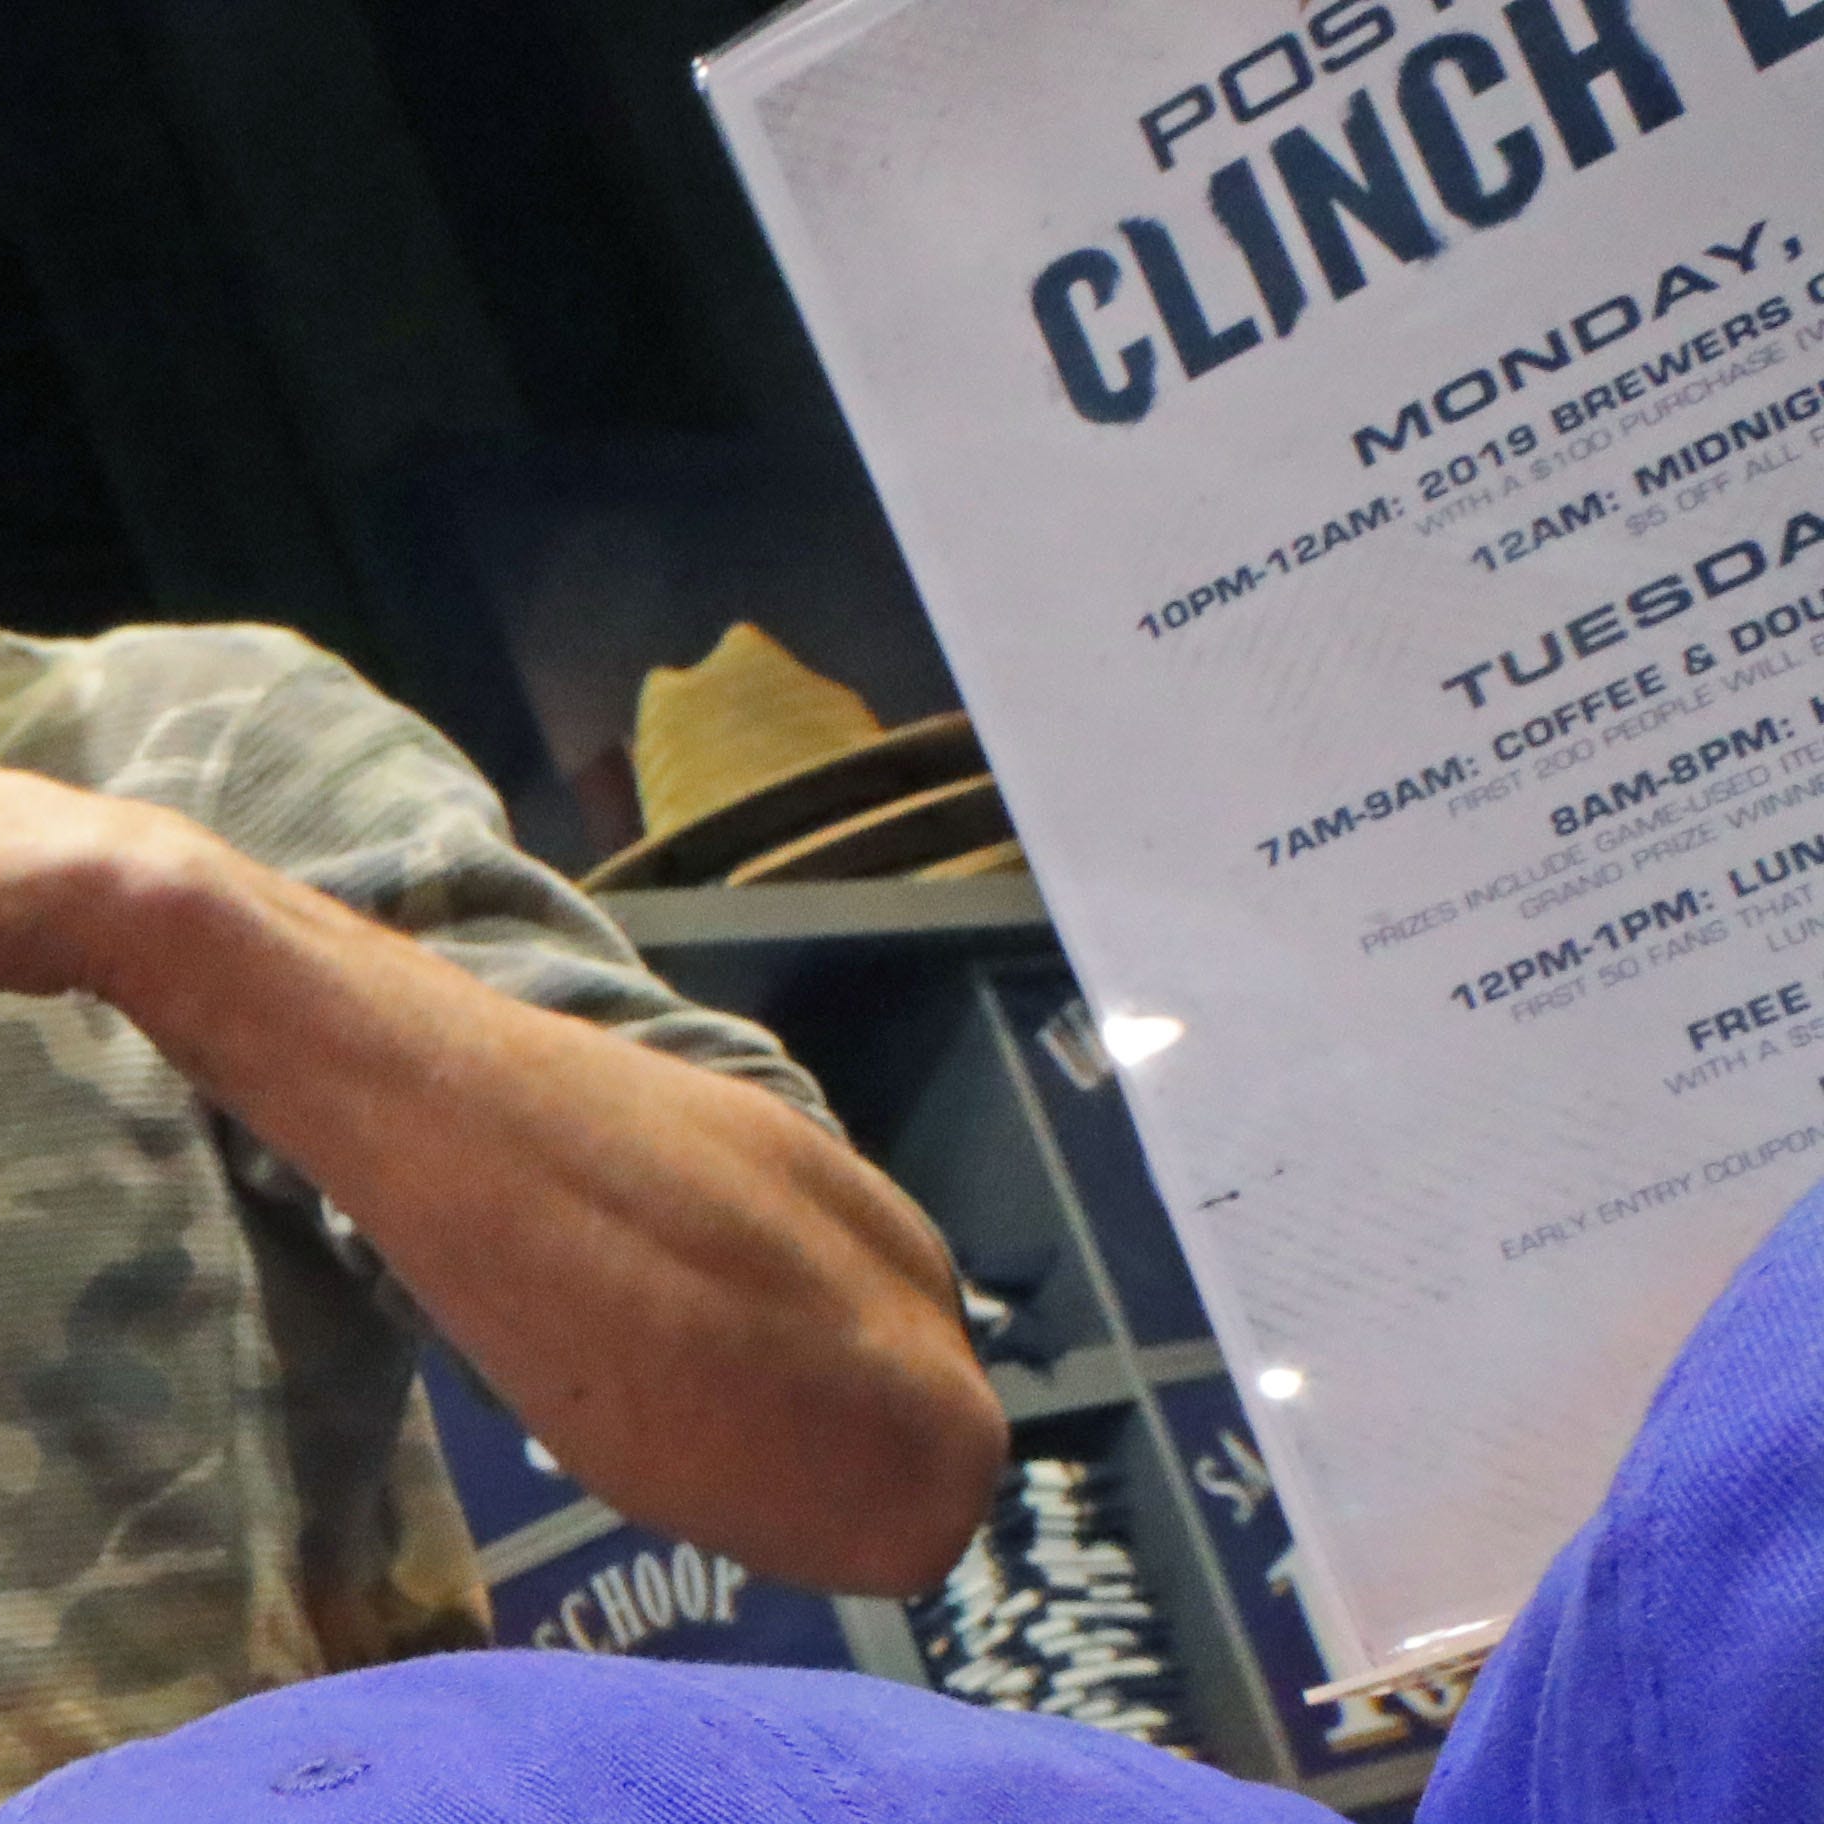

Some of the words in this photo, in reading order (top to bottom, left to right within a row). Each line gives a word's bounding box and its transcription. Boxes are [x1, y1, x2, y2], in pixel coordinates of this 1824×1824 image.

[1138, 0, 1461, 173] POS
[1030, 0, 1686, 425] CLINCH
[1352, 219, 1804, 468] MONDAY,
[1618, 342, 1788, 436] PURCHASE
[1138, 496, 1405, 639] 10PM-12AM:
[1416, 424, 1539, 502] 2019
[1550, 295, 1792, 434] BREWERS
[1470, 490, 1621, 572] 12AM:
[1632, 380, 1824, 496] MIDNIG
[1676, 473, 1730, 512] OFF
[1602, 682, 1715, 748] PEOPLE
[1719, 650, 1804, 694] WILL
[1256, 756, 1481, 867] 7AM-9AM:
[1492, 664, 1667, 762] COFFEE
[1683, 643, 1718, 677] &
[1550, 716, 1795, 836] 8AM-8PM:
[1359, 899, 1459, 955] PRIZES
[1463, 844, 1588, 912] INCLUDE
[1519, 861, 1624, 920] GRAND
[1631, 822, 1719, 871] PRIZE
[1450, 887, 1716, 1010] 12PM-1PM:
[1648, 919, 1729, 969] FANS
[1662, 1051, 1748, 1096] WITH
[1759, 1038, 1780, 1062] A
[1687, 981, 1811, 1052] FREE
[1500, 1211, 1587, 1261] EARLY
[1597, 1172, 1693, 1225] ENTRY
